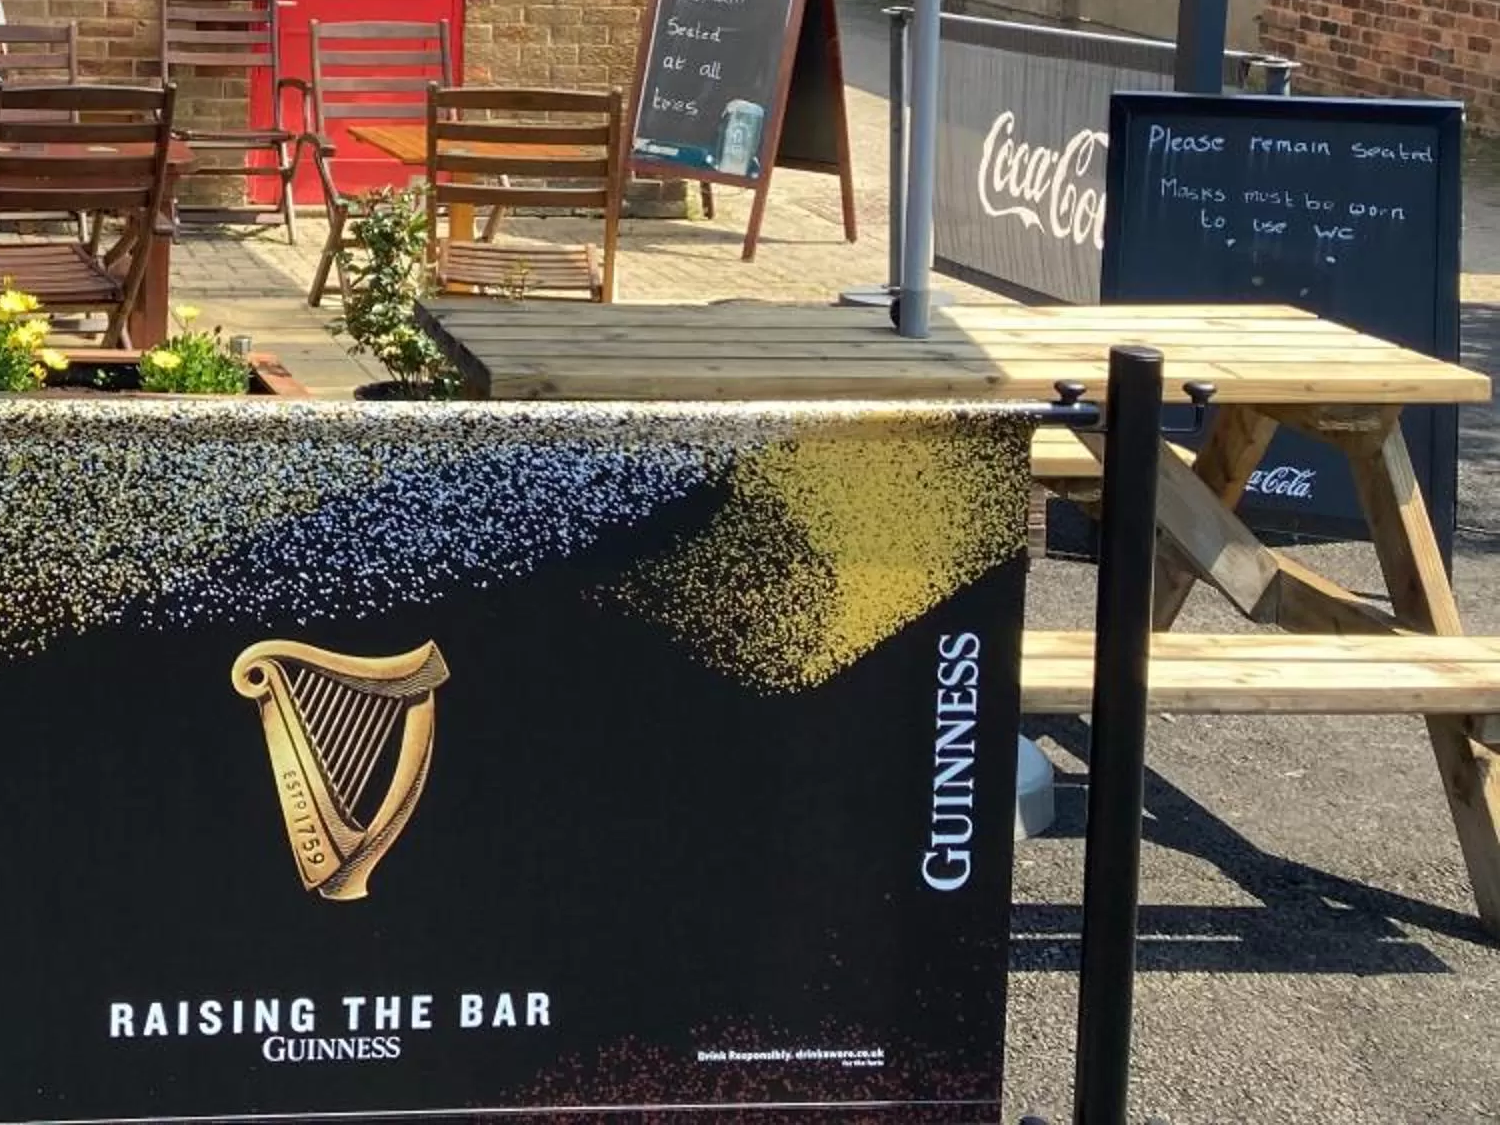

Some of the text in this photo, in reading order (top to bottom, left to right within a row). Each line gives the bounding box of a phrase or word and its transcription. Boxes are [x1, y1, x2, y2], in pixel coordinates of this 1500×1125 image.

[663, 55, 722, 80] at all
[1148, 124, 1226, 153] Please
[1249, 136, 1332, 157] remain
[977, 110, 1109, 251] Coca-Col
[1160, 177, 1227, 203] Masks
[1243, 190, 1296, 209] must
[1348, 201, 1406, 221] worn
[1200, 209, 1226, 229] to
[1252, 218, 1288, 234] use
[921, 632, 981, 892] GUINNESS
[293, 814, 326, 865] 1759
[109, 991, 551, 1038] RAISING THE BAR
[262, 1035, 401, 1062] GUINNESS
